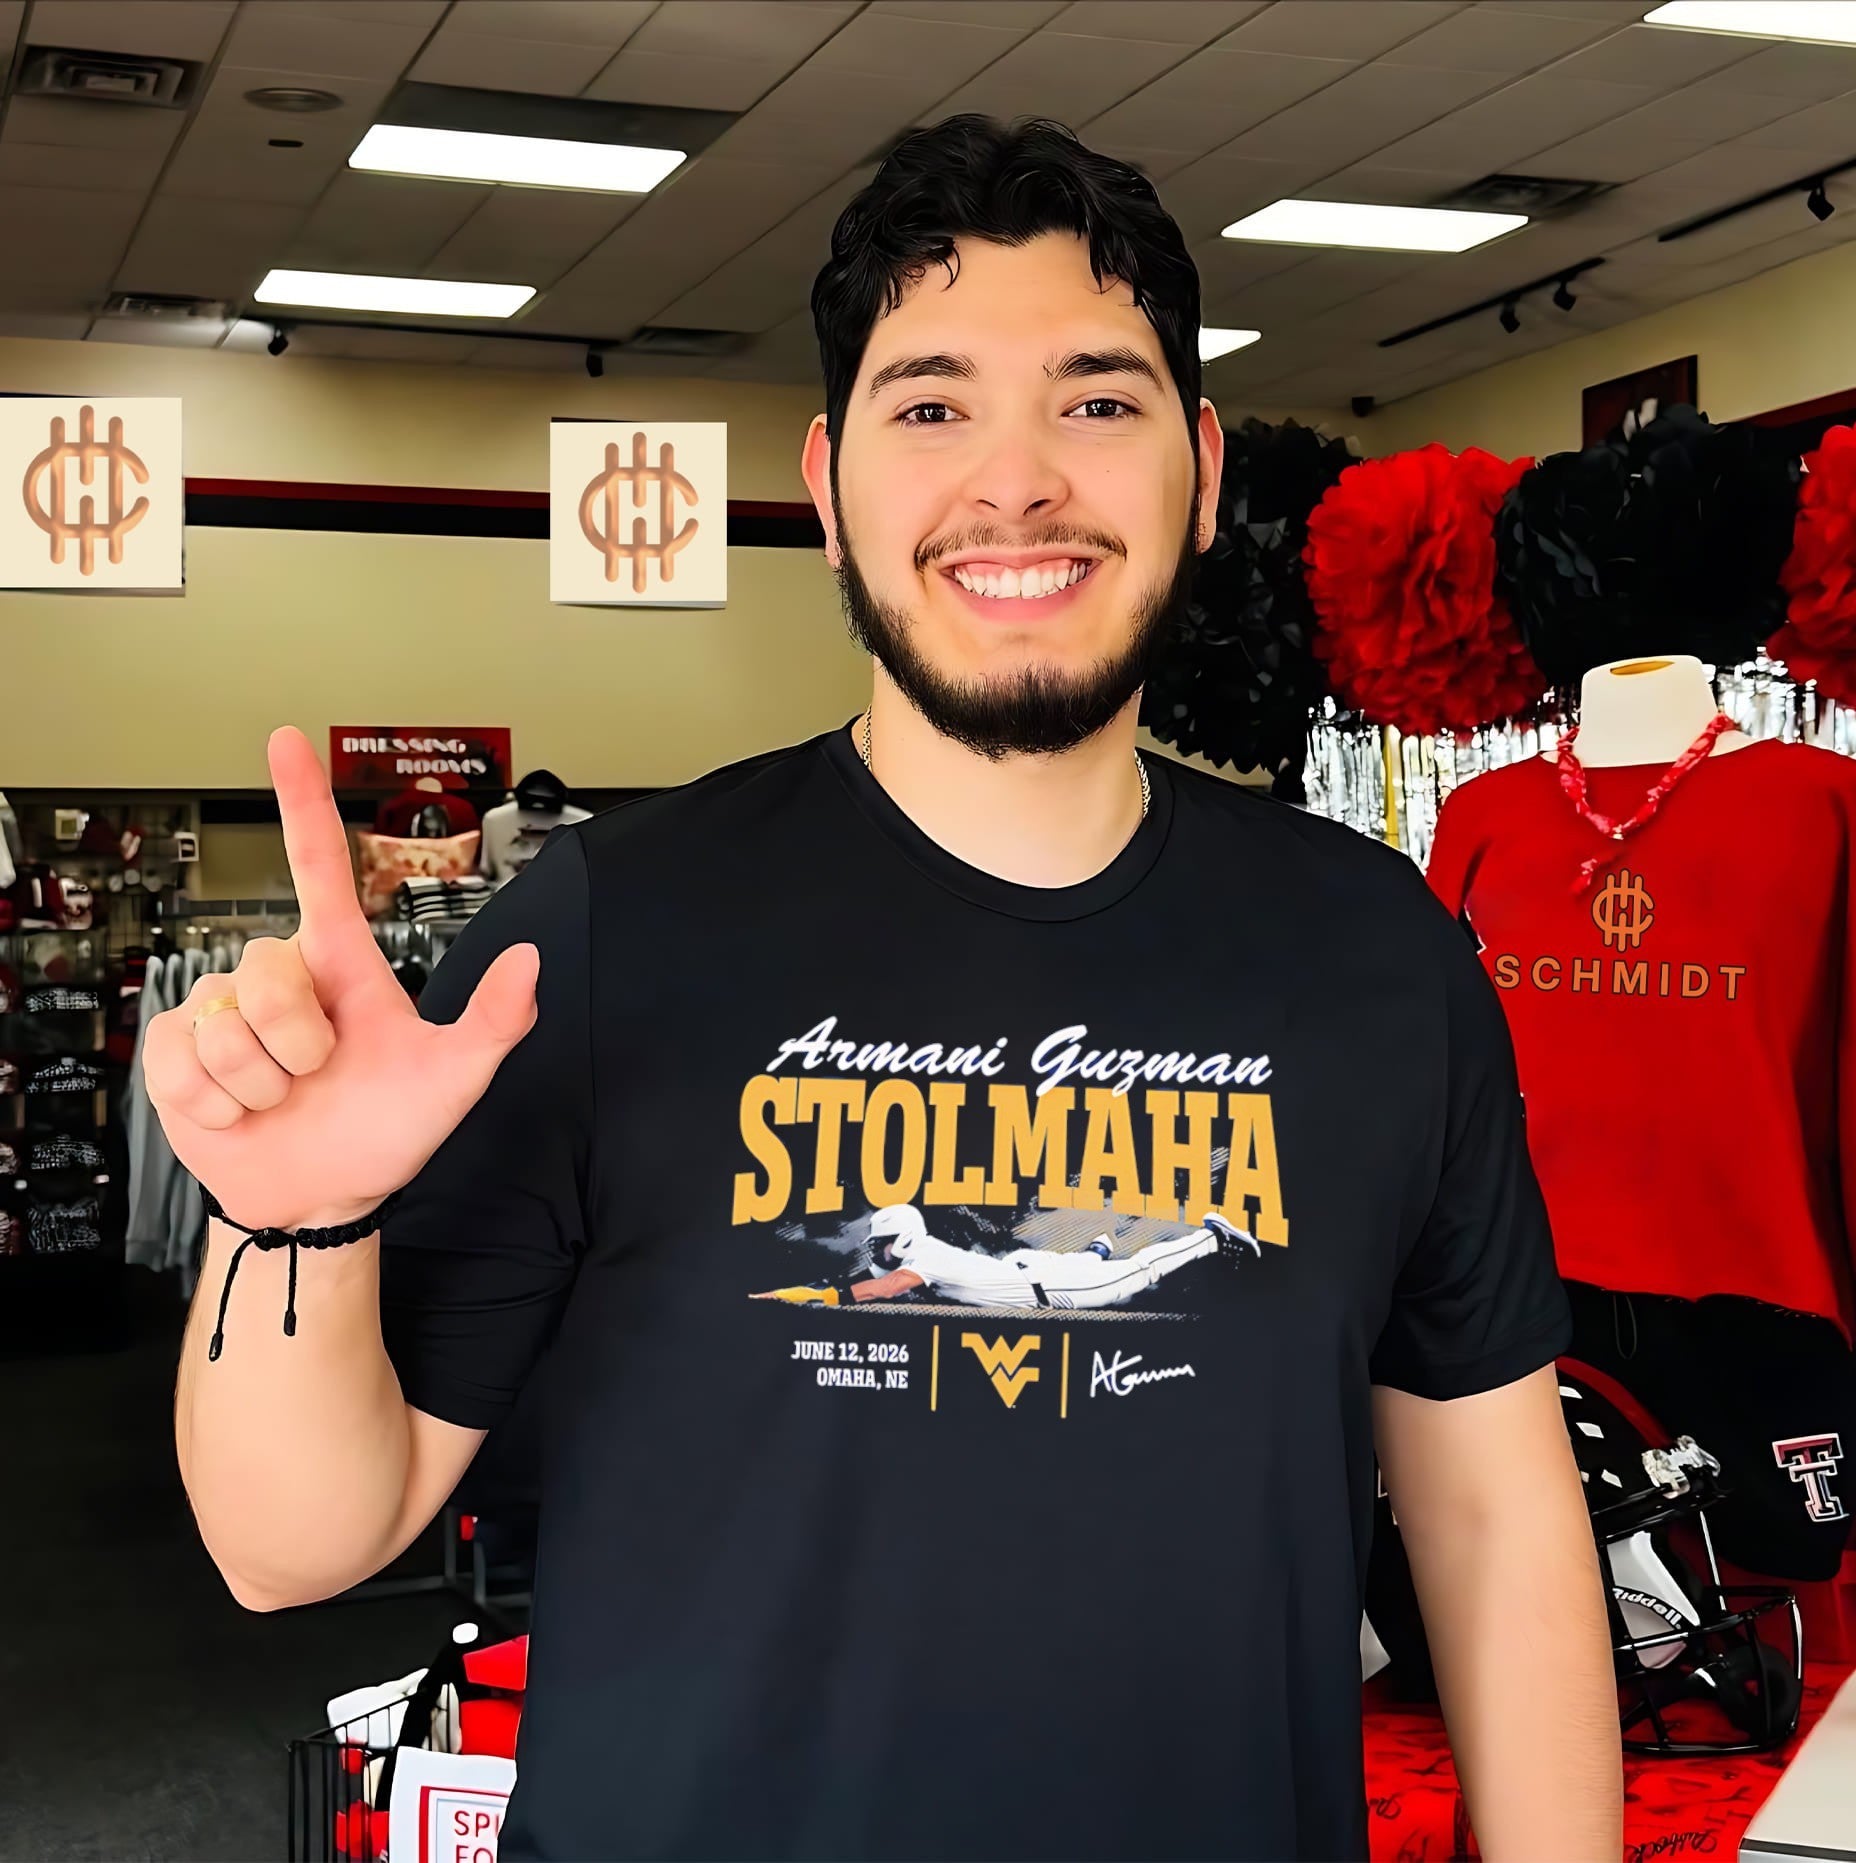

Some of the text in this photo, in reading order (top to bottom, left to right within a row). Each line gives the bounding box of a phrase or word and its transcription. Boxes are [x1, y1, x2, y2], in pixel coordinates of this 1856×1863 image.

[342, 737, 466, 754] DRESSING
[396, 758, 487, 775] ROOMS
[1494, 953, 1747, 1000] SCHMIDT
[766, 1015, 1273, 1098] Armani Guzman
[731, 1073, 1290, 1249] STOLMAHA
[790, 1340, 910, 1364] JUNE 12, 2026
[816, 1367, 909, 1390] OMAHA, NE
[1612, 1588, 1682, 1626] Riddell
